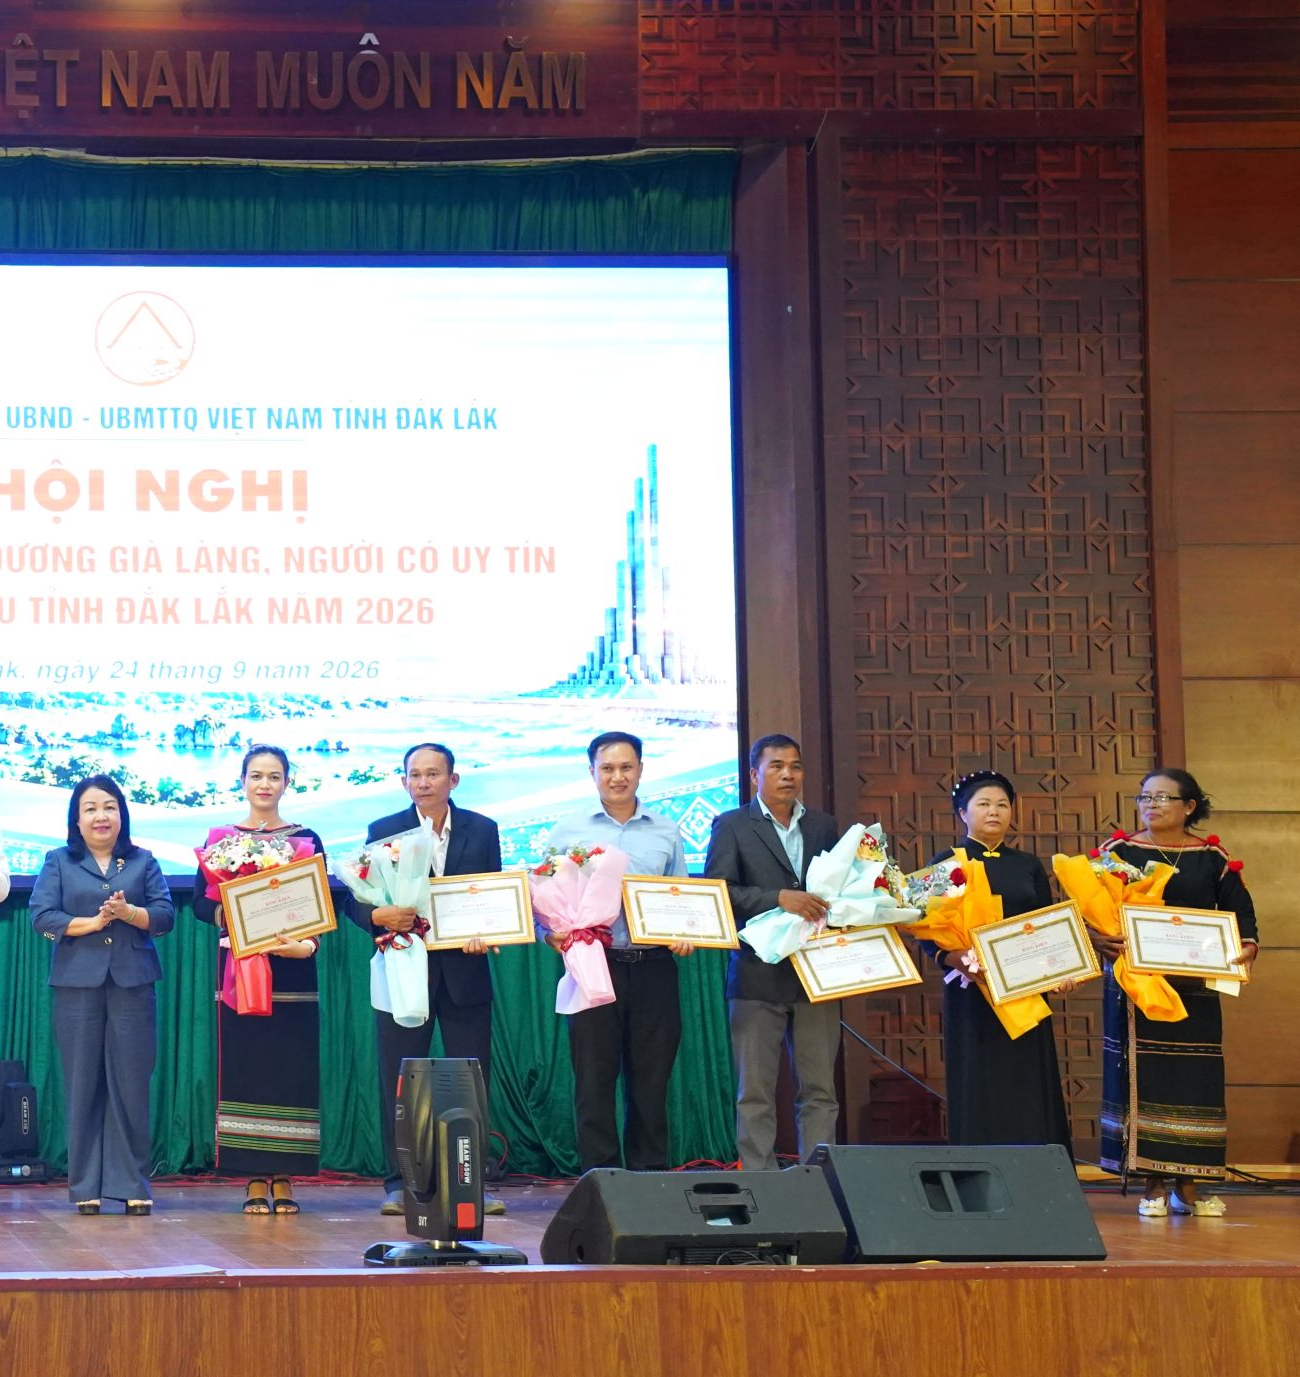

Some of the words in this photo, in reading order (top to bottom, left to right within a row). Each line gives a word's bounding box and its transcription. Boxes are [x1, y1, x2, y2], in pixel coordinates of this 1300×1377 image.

[101, 50, 230, 109] NAM
[256, 32, 431, 111] MUÔN
[456, 36, 586, 111] NĂM
[6, 406, 73, 429] UBND
[101, 406, 198, 432] UBMTTQ
[267, 407, 323, 430] NAM
[136, 468, 308, 524] NGHỊ
[452, 546, 491, 574] UY
[356, 597, 435, 625] 2026
[110, 660, 139, 679] 24
[232, 660, 246, 679] 9
[320, 660, 381, 679] 2026
[463, 1162, 471, 1184] 450W
[418, 1216, 428, 1227] SVT
